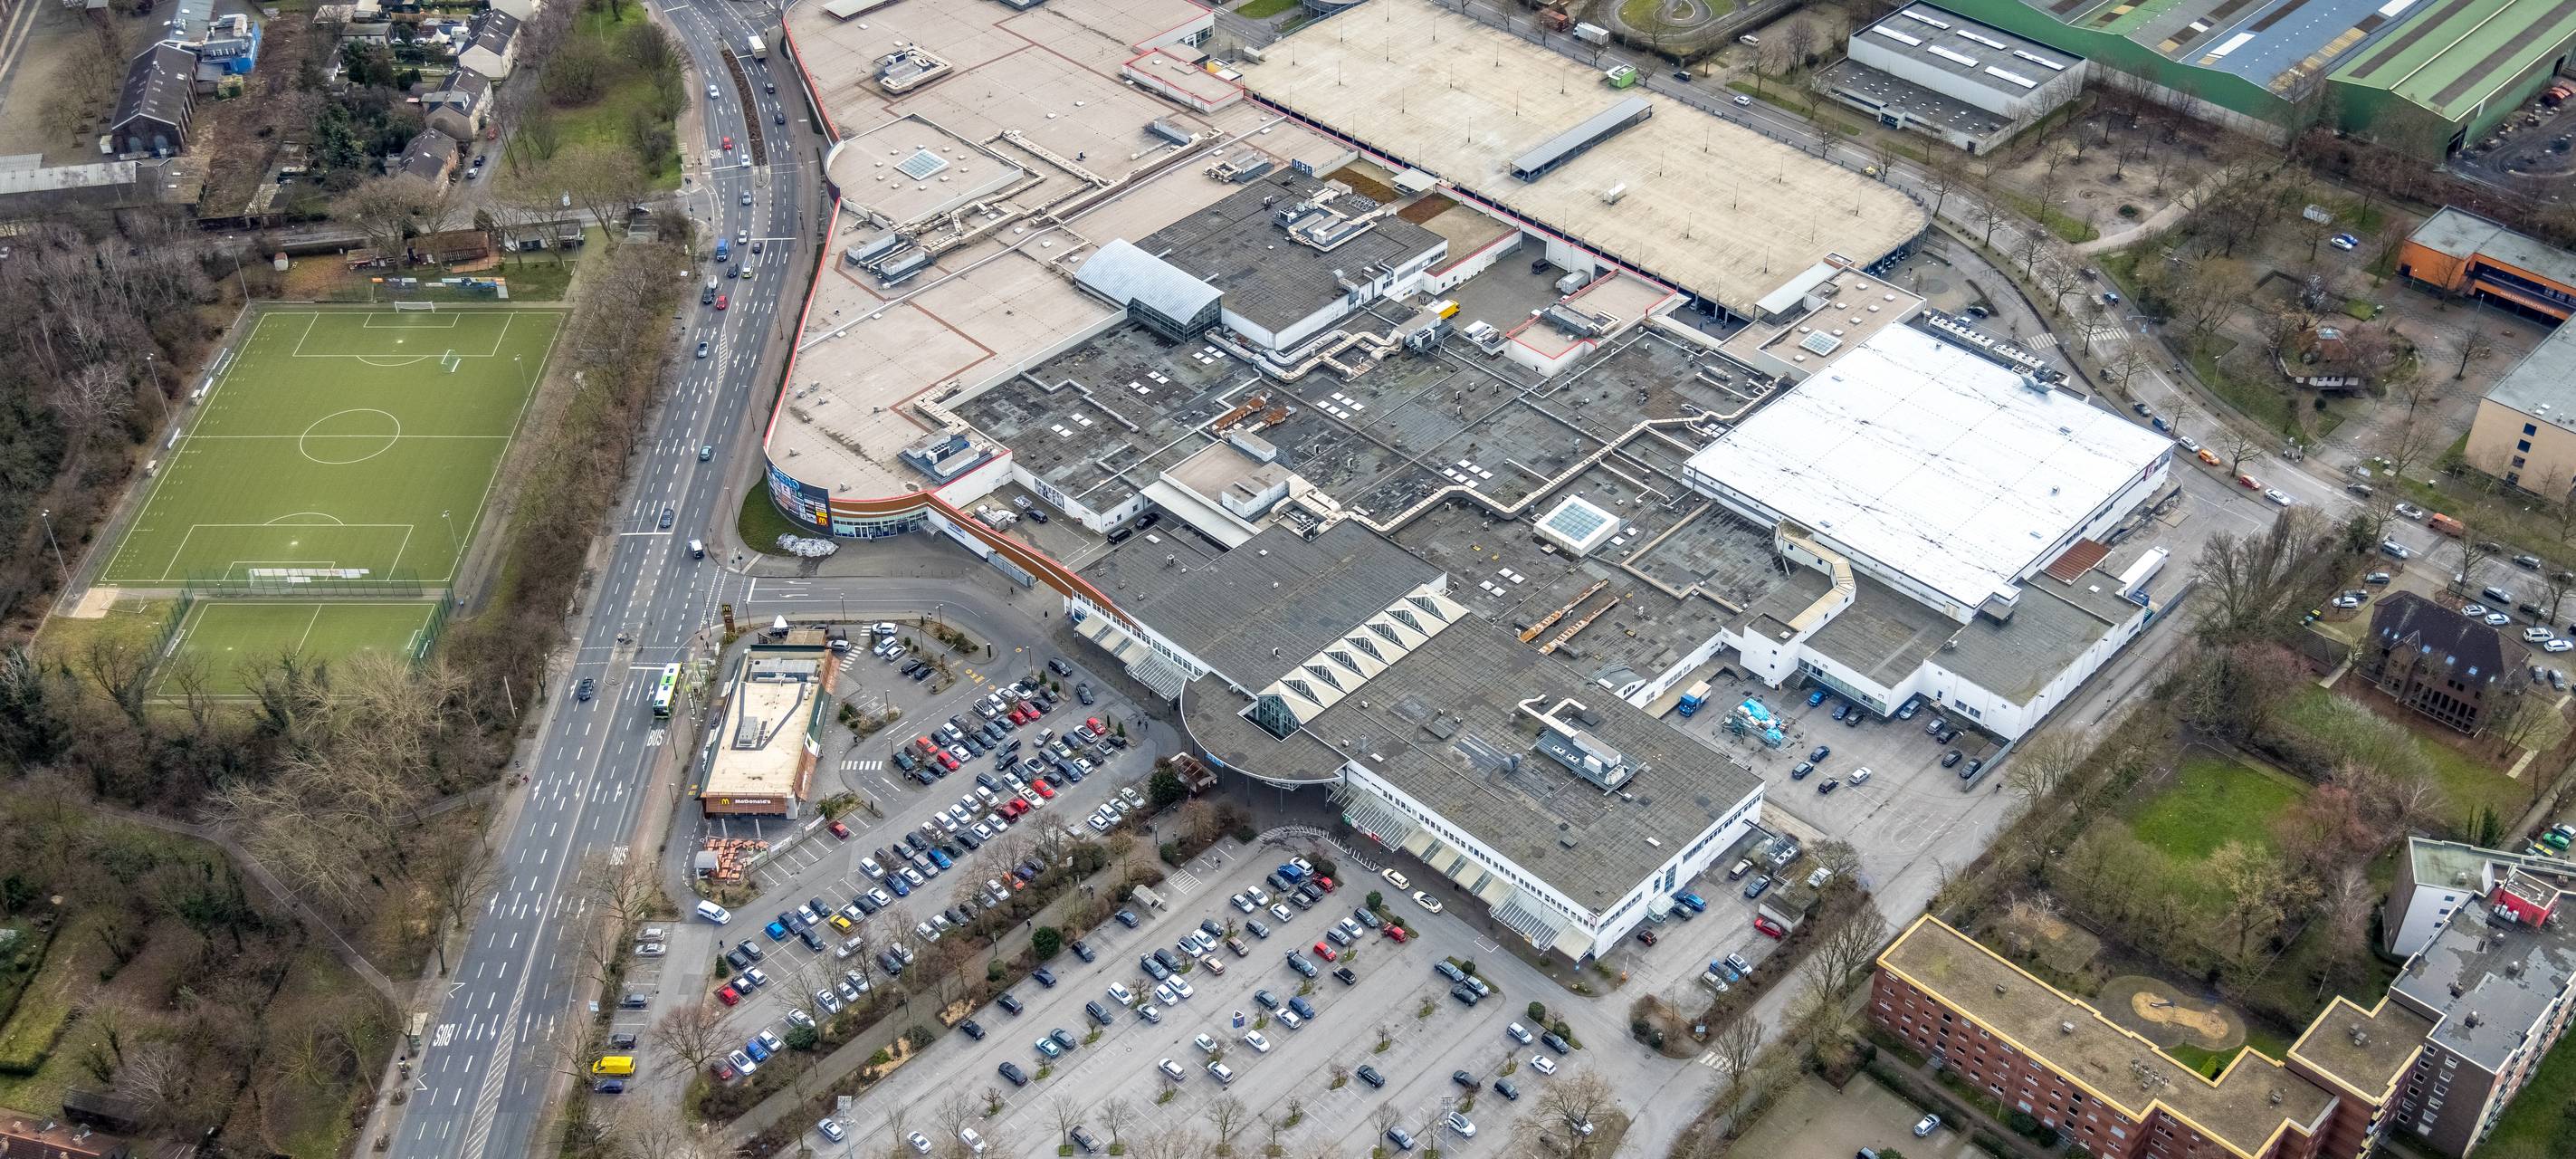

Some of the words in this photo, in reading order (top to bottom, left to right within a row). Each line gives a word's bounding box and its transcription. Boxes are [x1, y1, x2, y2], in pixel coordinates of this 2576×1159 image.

[646, 729, 665, 746] BUS
[609, 846, 629, 866] BUS
[434, 1023, 455, 1046] BUS
